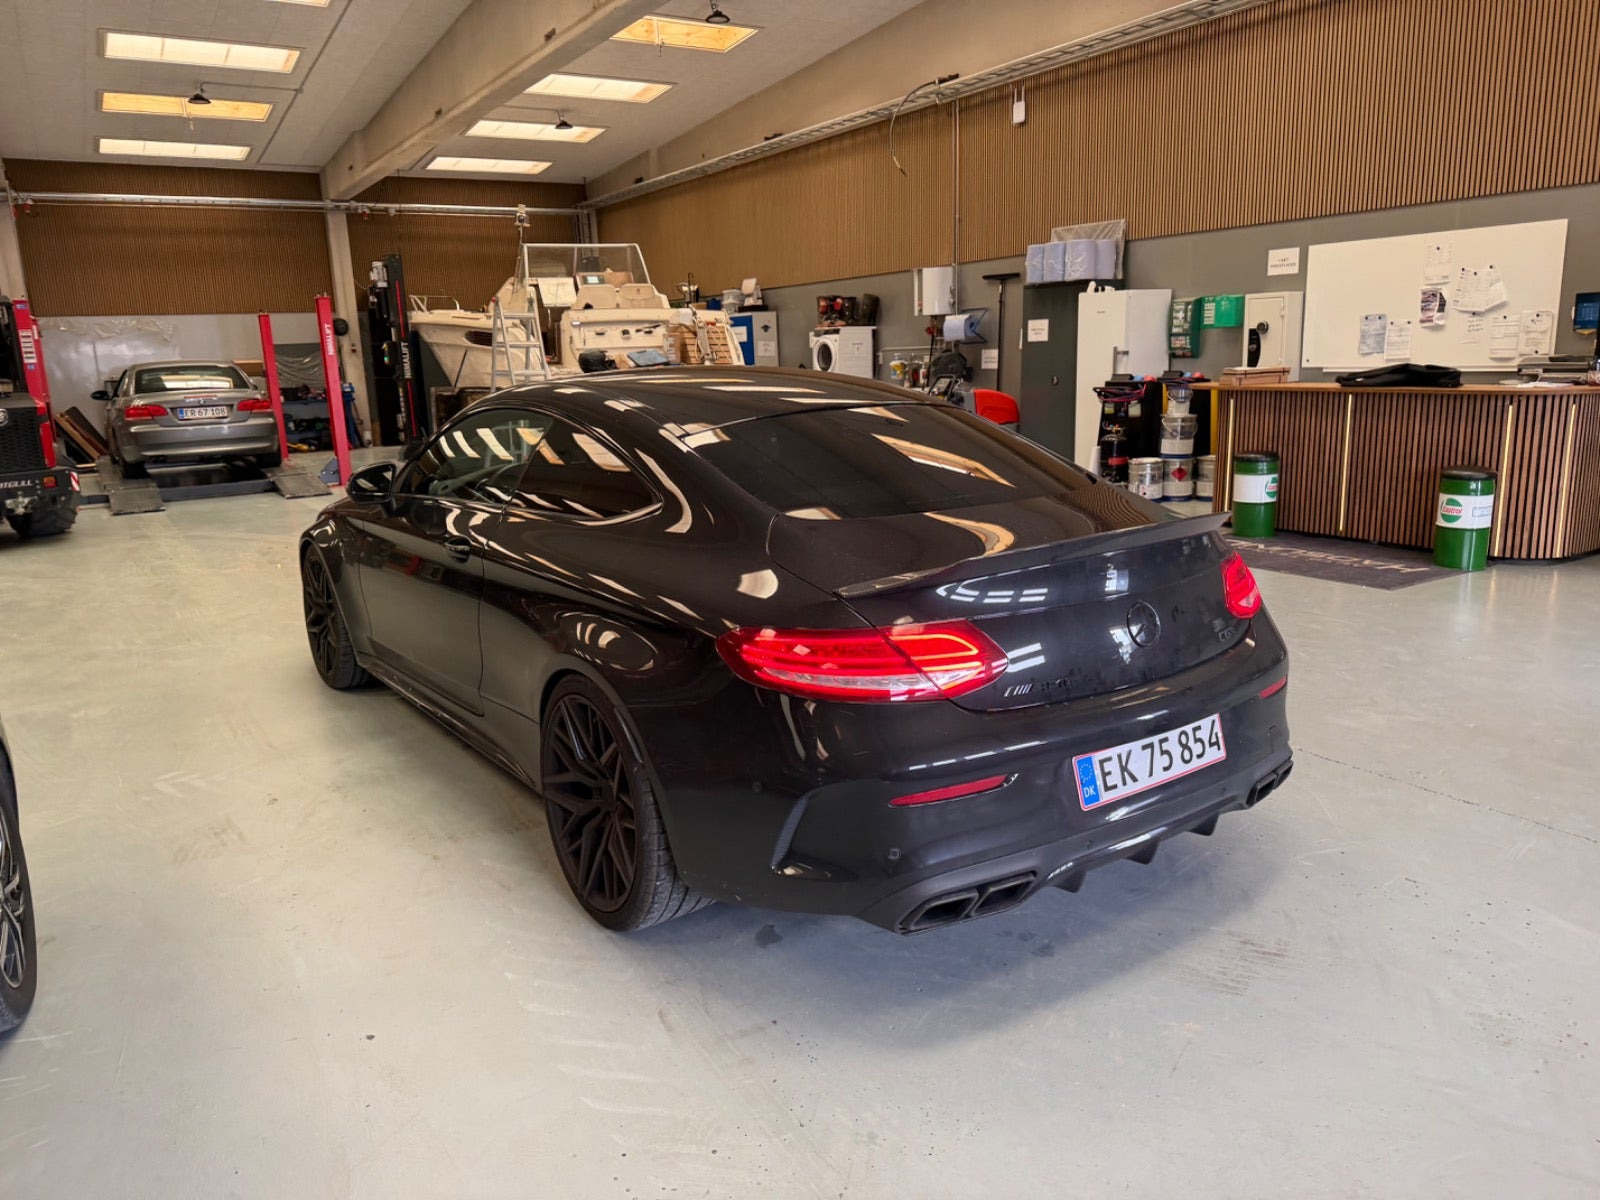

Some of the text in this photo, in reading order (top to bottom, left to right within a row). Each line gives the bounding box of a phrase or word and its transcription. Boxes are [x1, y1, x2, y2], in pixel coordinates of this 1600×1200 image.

[400, 341, 412, 379] NIMALIFT
[184, 409, 196, 417] ER
[197, 408, 208, 416] 67
[211, 407, 226, 416] 108
[1098, 719, 1221, 792] EK 75 854
[1084, 786, 1097, 798] DK
